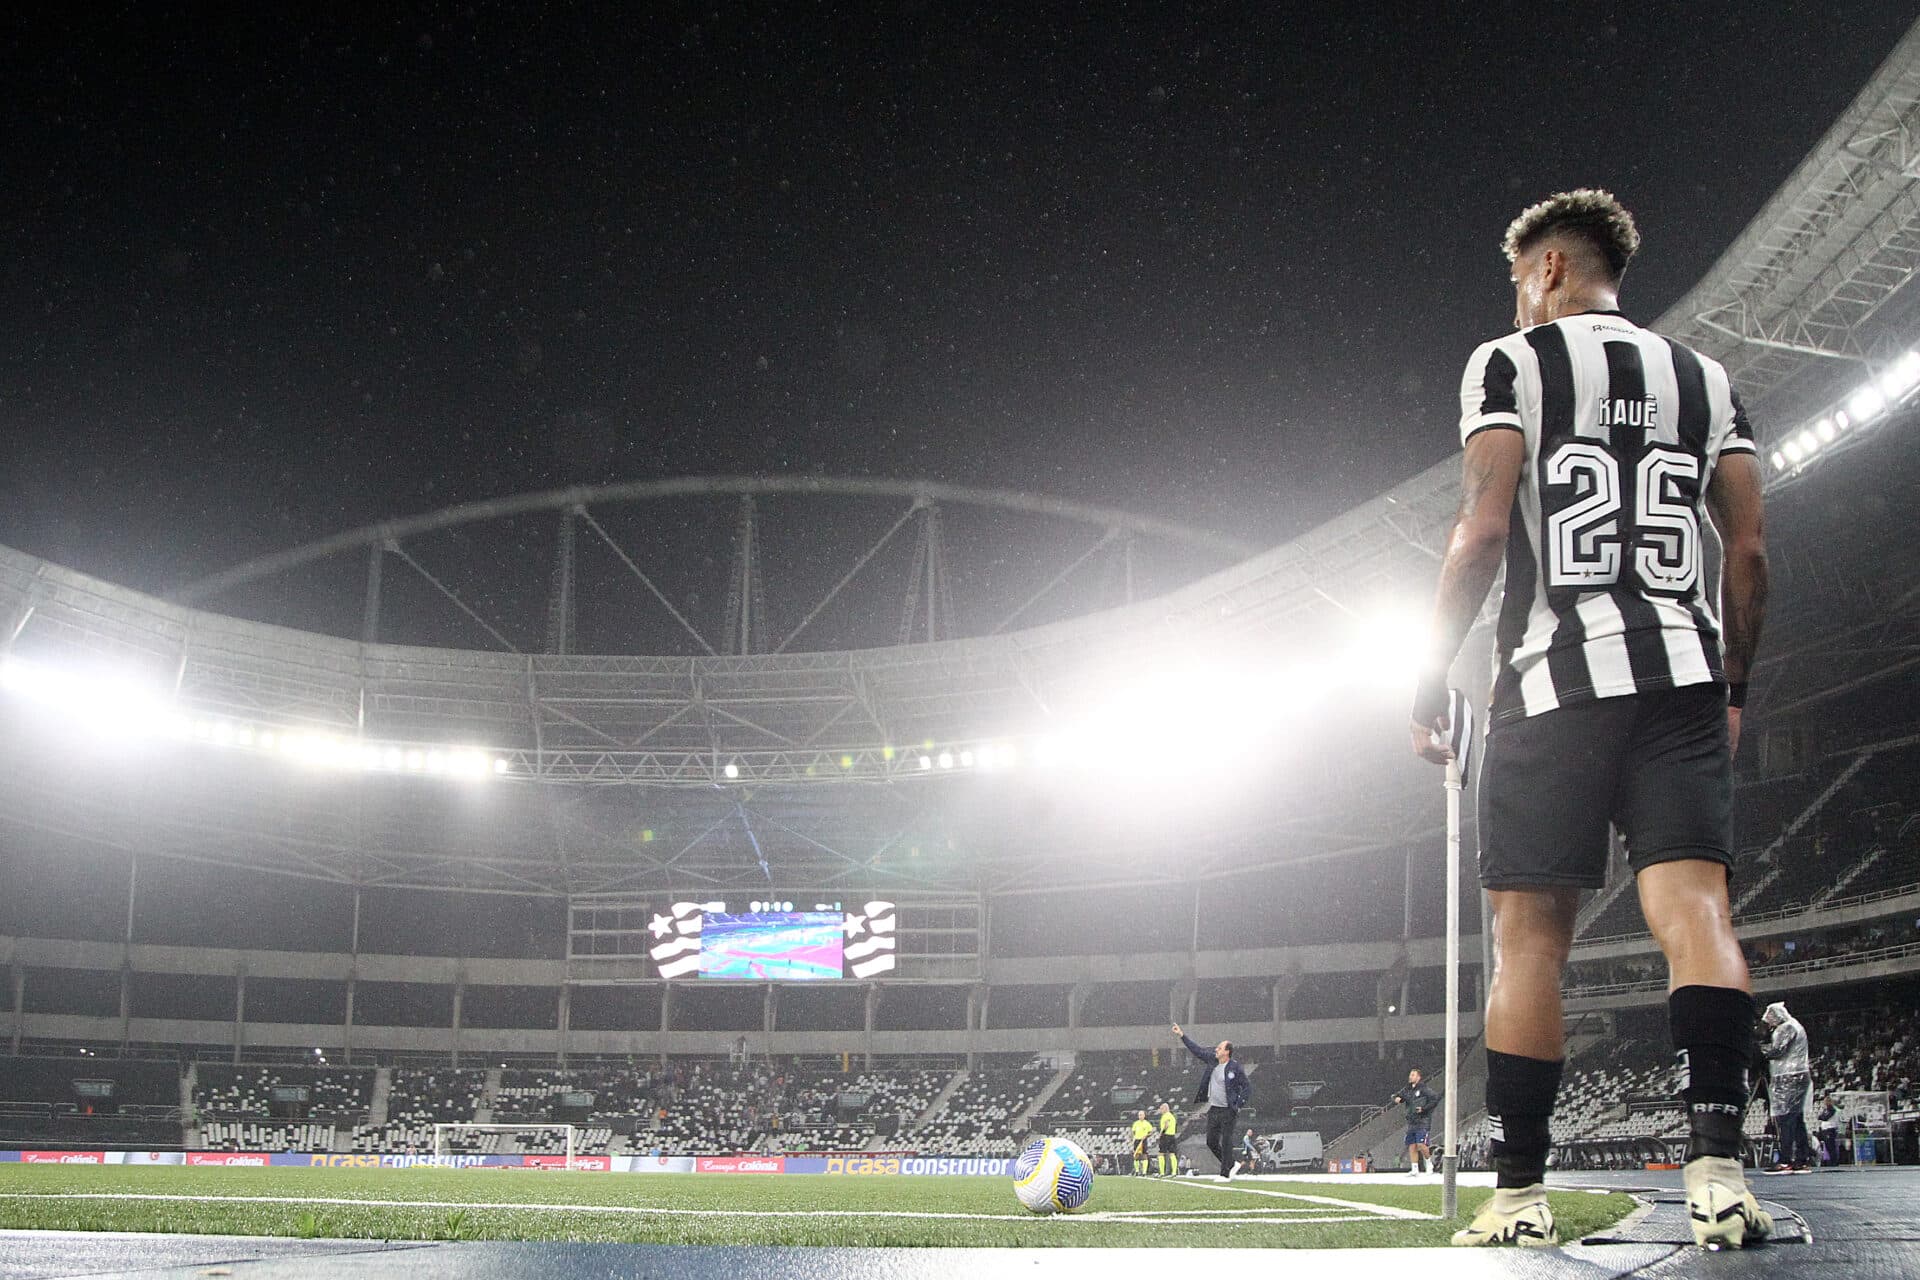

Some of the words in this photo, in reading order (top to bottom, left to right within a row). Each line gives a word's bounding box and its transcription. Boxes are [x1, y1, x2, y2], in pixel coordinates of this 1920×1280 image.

[1598, 393, 1657, 429] KAUÊ
[1547, 443, 1699, 591] 25
[328, 1155, 380, 1168] casa
[738, 1160, 778, 1171] Colônia
[845, 1159, 900, 1175] casa
[901, 1158, 1009, 1175] construtor
